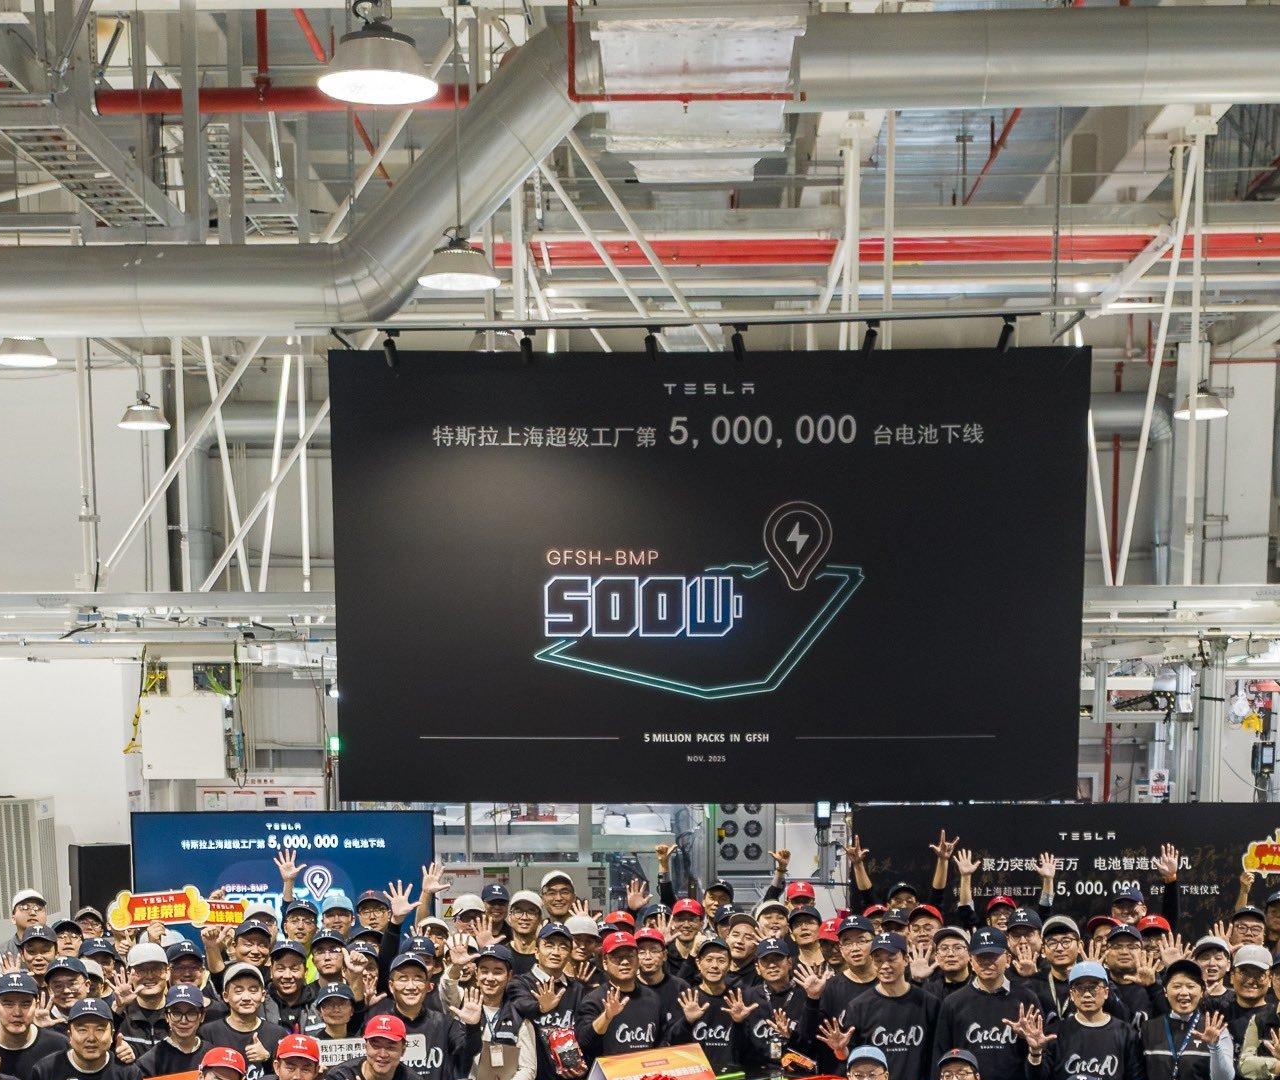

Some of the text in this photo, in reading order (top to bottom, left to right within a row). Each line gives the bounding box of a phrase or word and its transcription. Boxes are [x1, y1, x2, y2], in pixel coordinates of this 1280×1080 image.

[663, 382, 756, 395] TESLA
[432, 415, 985, 450] 特斯拉上海超级工厂第 5,000,000 台电池下线
[546, 549, 660, 566] GFSH-BMP
[643, 731, 770, 743] 5 MILLION PACKS IN GFSH
[686, 755, 726, 763] NOV. 2025
[1059, 832, 1117, 841] TESLA
[982, 856, 1192, 871] 聚力突破百万 电池智造创凡
